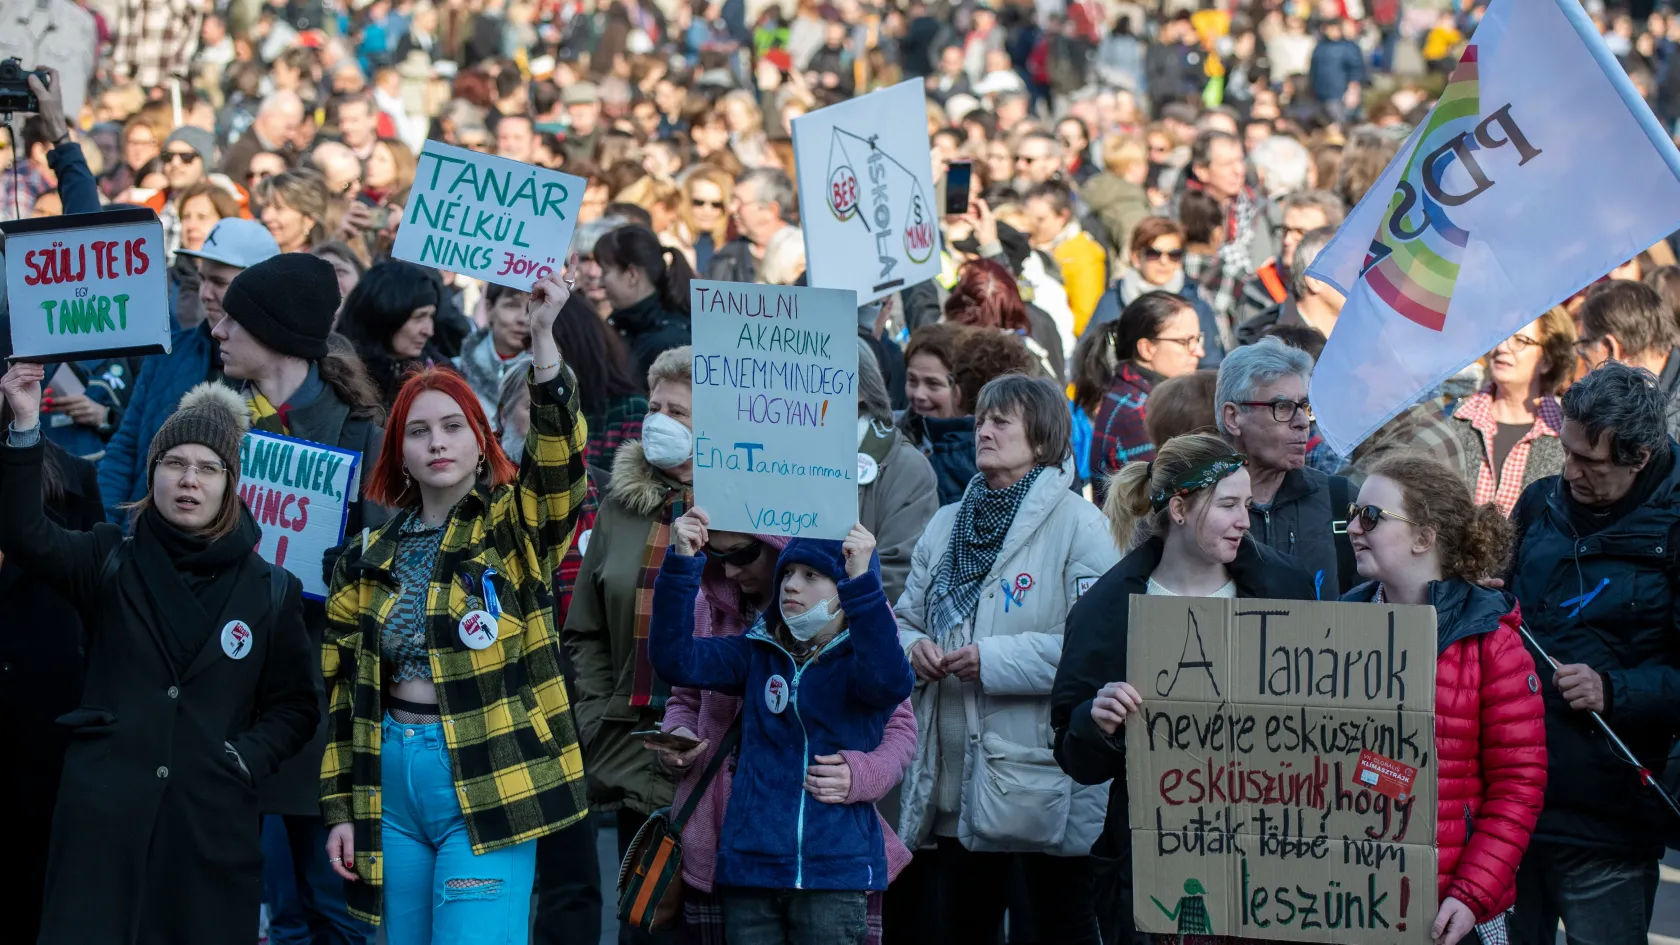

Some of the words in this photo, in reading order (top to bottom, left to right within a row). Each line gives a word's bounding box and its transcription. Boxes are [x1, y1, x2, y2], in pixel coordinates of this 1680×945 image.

[421, 151, 569, 221] TANÁR
[833, 171, 857, 208] BÉR
[409, 193, 531, 248] NÉLKÜL
[866, 152, 899, 279] ISKOLA
[904, 220, 934, 250] MUNKA
[24, 241, 87, 286] SZÜLJ
[91, 240, 120, 280] TE
[124, 237, 150, 277] IS
[419, 234, 494, 270] NINCS
[75, 287, 89, 298] EGY
[695, 287, 799, 320] TANULNI
[40, 293, 130, 336] TANÁRT
[736, 322, 832, 360] AKARUNK,
[737, 393, 829, 428] HOGYAN!
[239, 435, 343, 503] ANULNÉK,
[1156, 606, 1221, 698] A
[1234, 610, 1408, 702] Tanárok
[1144, 699, 1256, 755] nevére
[1265, 703, 1428, 769] esküszünk,
[1361, 760, 1410, 783] KLÍMASZTRÁJK
[1333, 761, 1417, 842] hogy
[1342, 834, 1406, 873] nem
[1240, 857, 1411, 932] leszünk!
